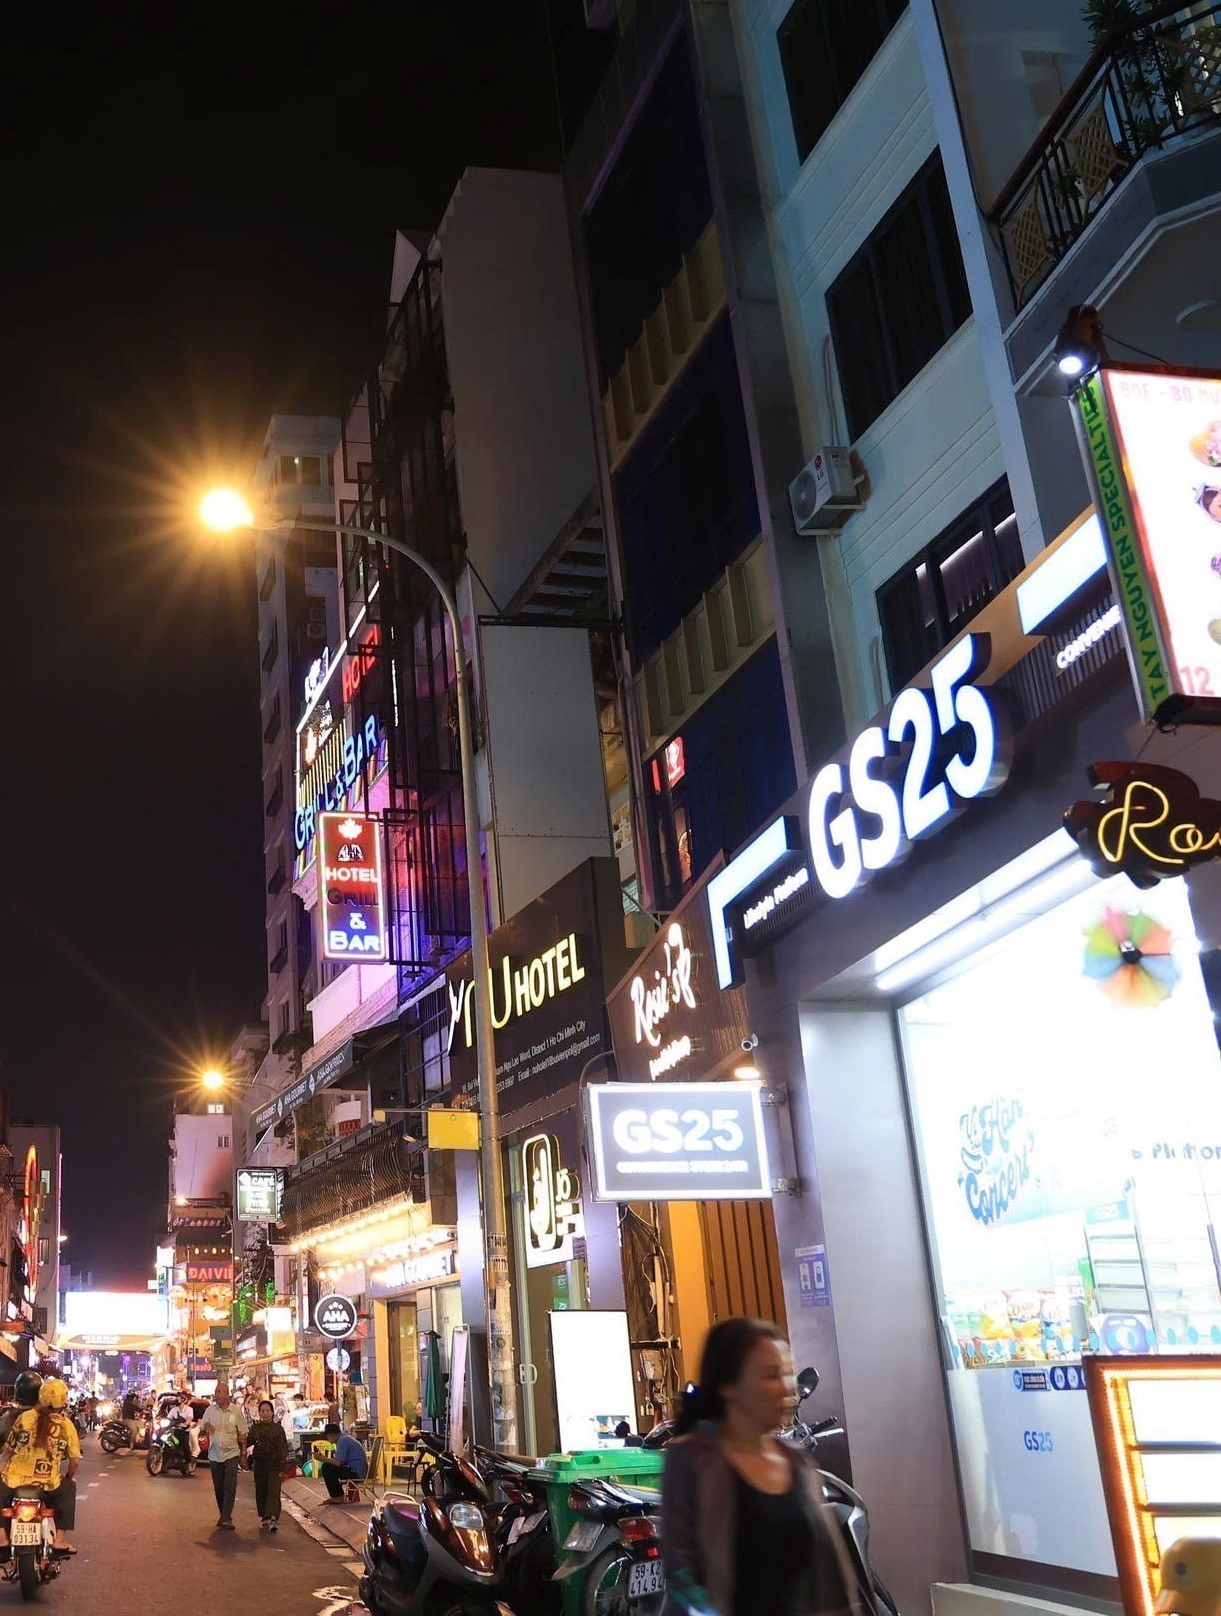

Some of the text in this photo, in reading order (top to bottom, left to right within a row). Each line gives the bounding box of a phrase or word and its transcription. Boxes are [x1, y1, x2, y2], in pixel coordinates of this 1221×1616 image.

[343, 714, 378, 787] BAR
[809, 633, 995, 899] GS25
[1098, 781, 1221, 864] Ro
[326, 867, 379, 882] HOTEL
[350, 912, 367, 930] &
[514, 932, 585, 1017] HOTEL
[613, 1108, 744, 1154] GS25
[323, 1310, 350, 1322] AHA
[1024, 1430, 1054, 1452] GS25
